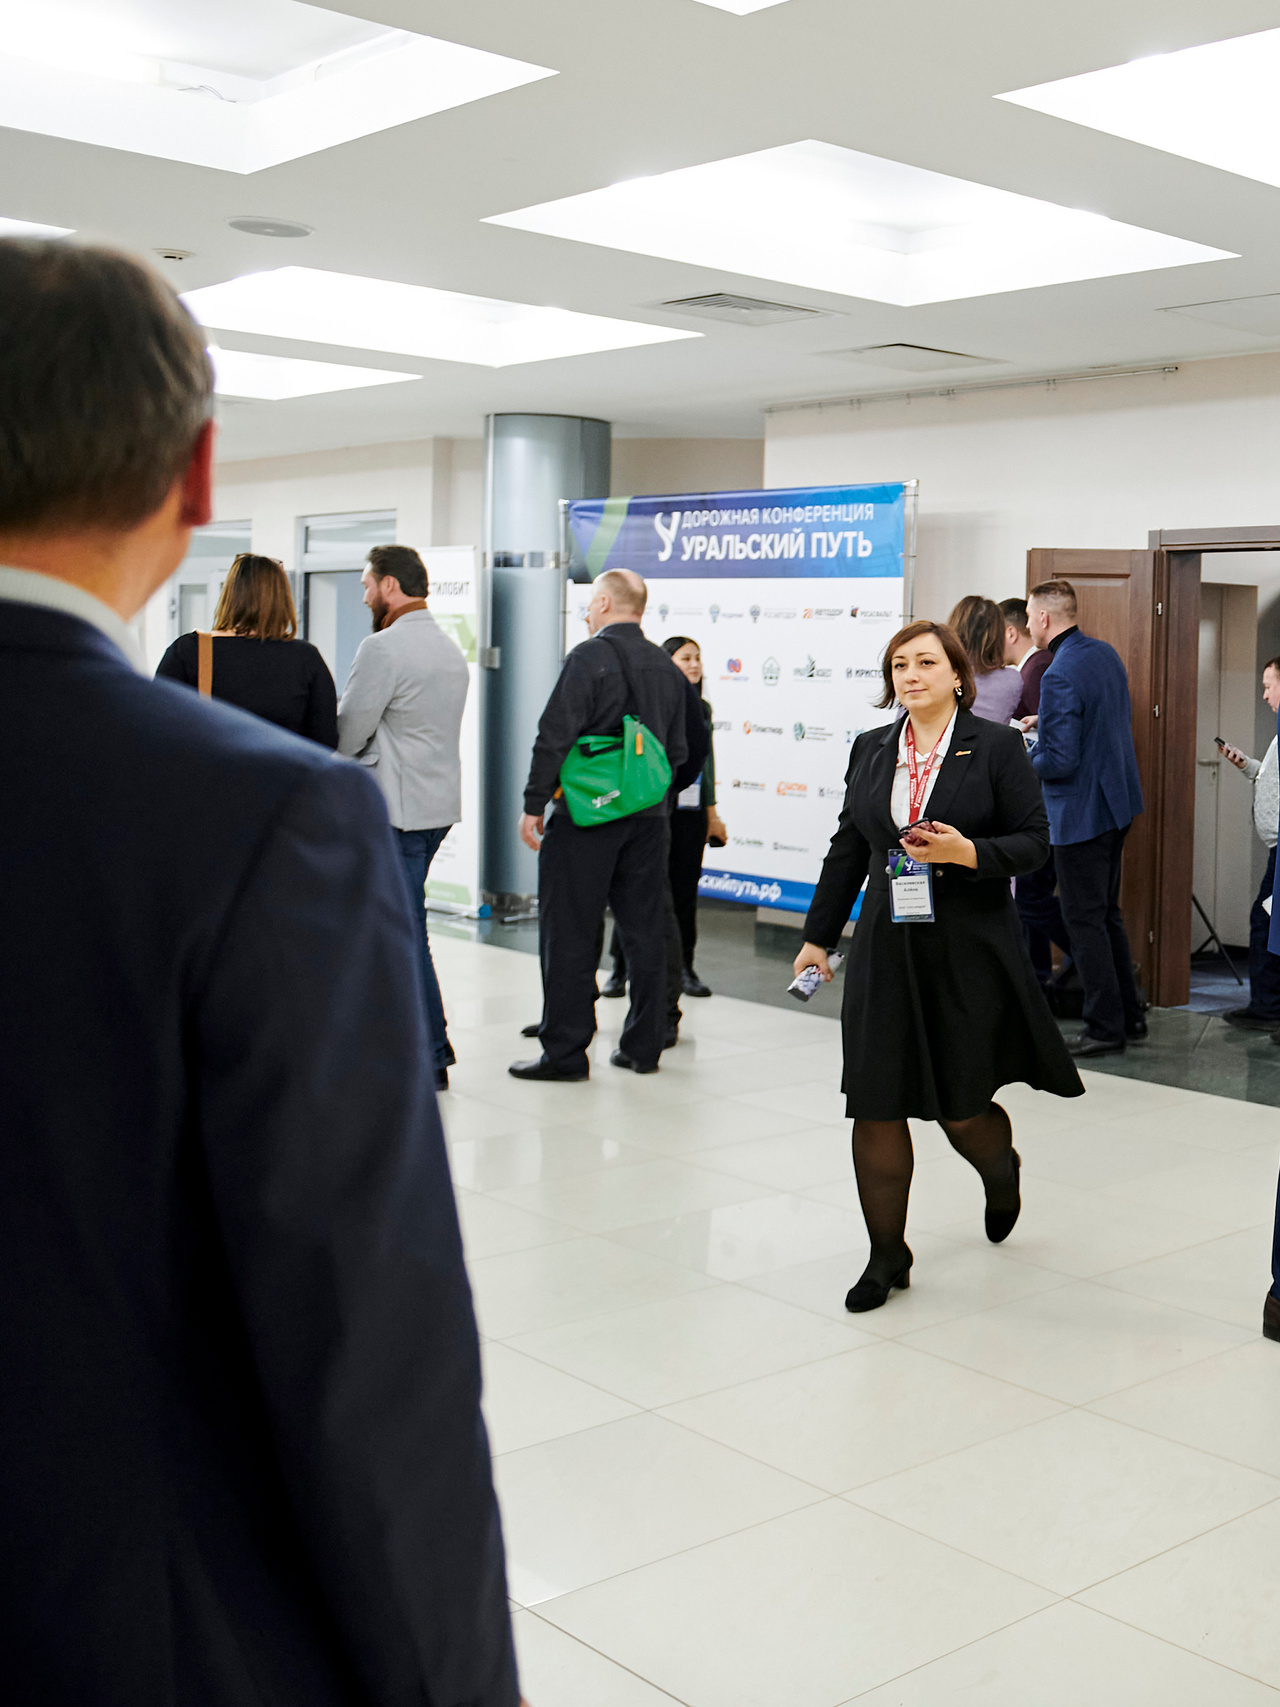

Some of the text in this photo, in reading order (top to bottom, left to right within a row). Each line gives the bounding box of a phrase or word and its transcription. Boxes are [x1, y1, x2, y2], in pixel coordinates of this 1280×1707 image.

[681, 503, 874, 530] ДОРОЖНАЯ КОНФЕРЕНЦИЯ
[681, 527, 873, 561] УРАЛЬСКИЙ ПУТЬ
[428, 581, 470, 595] ТИЛОБИТ
